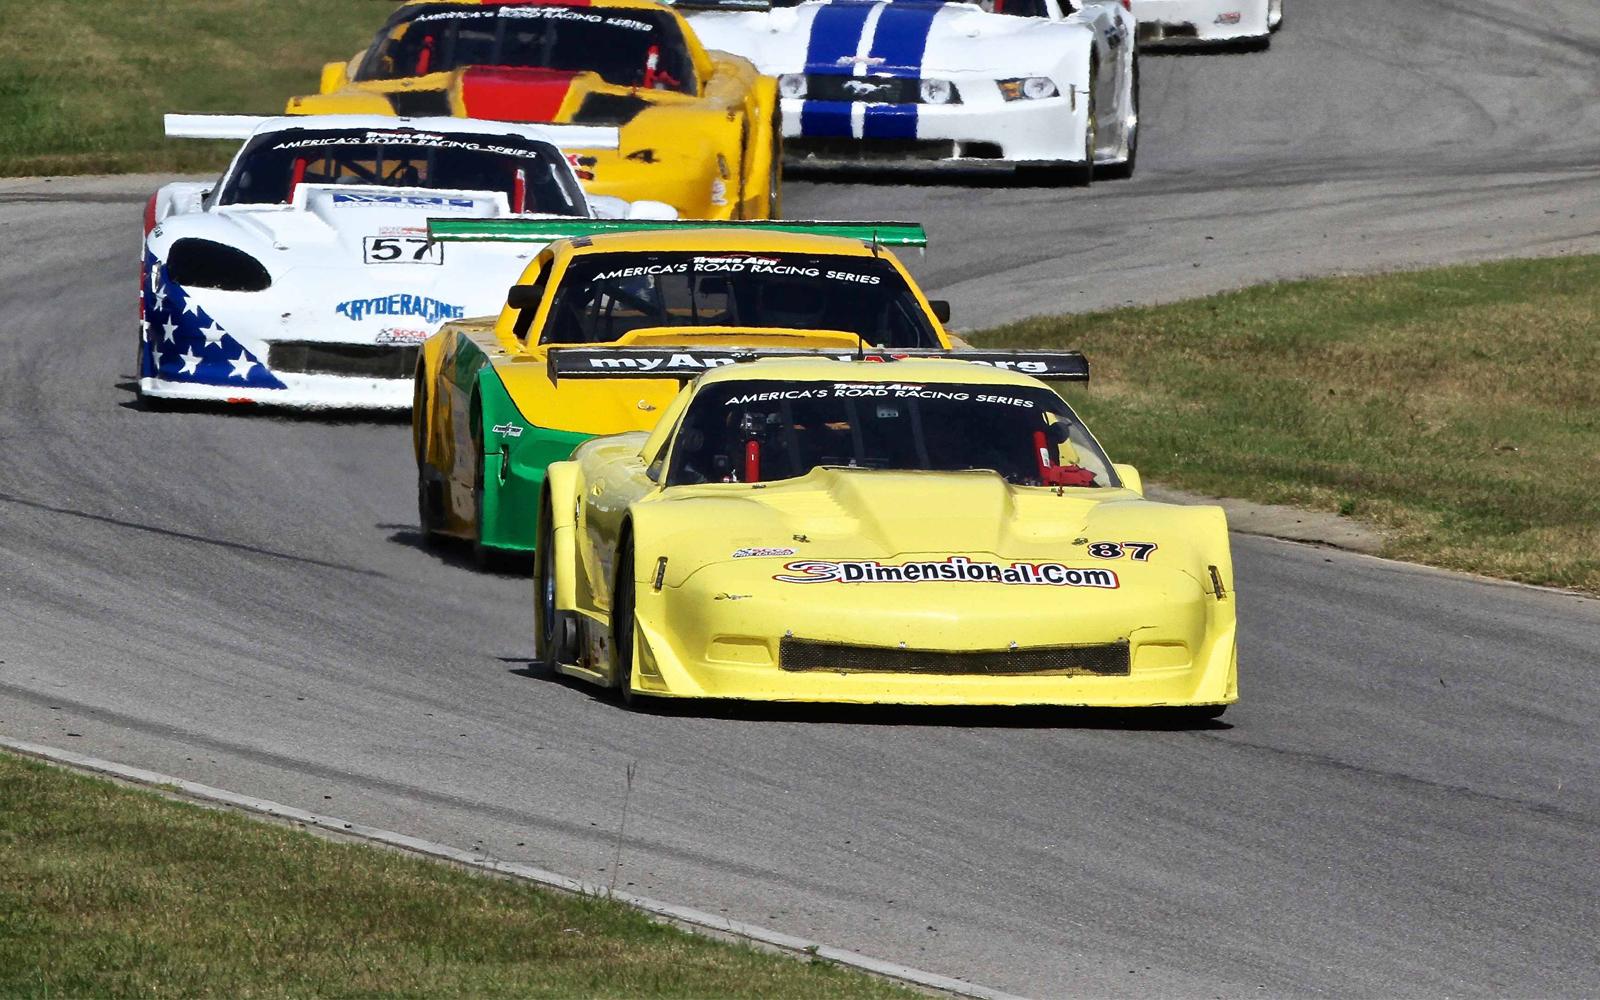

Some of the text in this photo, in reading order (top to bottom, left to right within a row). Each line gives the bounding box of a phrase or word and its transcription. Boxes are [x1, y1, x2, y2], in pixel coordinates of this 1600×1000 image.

[273, 137, 538, 159] AMERICA'S ROAD RACING SERIES
[371, 238, 436, 261] 57
[742, 257, 778, 265] Am
[592, 263, 881, 286] AMERICA'S ROAD RACING SERIES
[725, 389, 1035, 409] AMERICA'S ROAD RACING SERIES
[1088, 541, 1158, 561] 87
